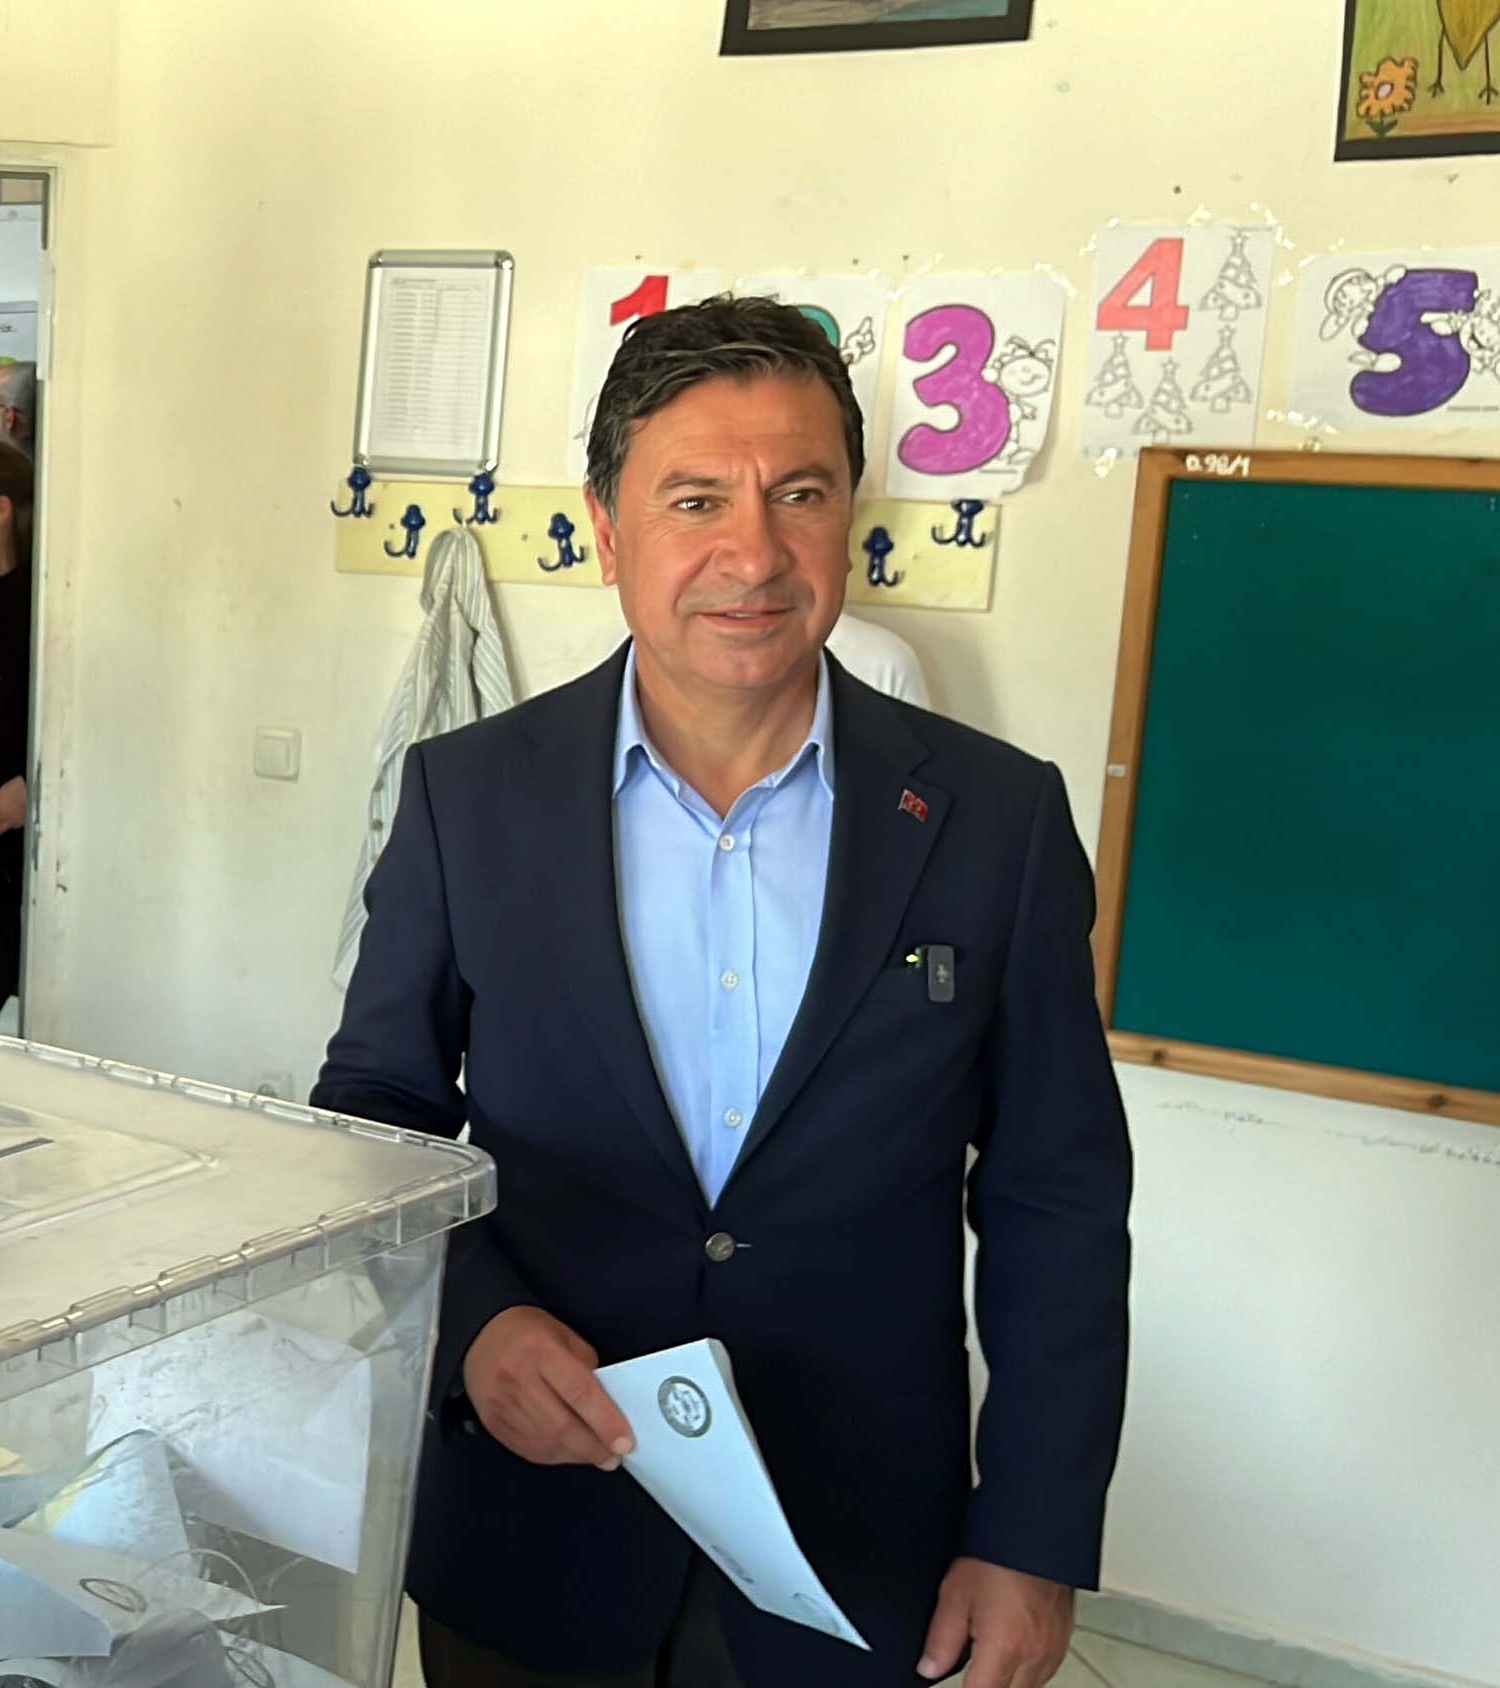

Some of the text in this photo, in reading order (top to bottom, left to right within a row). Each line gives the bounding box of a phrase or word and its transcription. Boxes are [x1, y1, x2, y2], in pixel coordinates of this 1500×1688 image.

[1096, 237, 1190, 351] 4
[1350, 267, 1479, 417] 5
[898, 304, 1011, 474] 3
